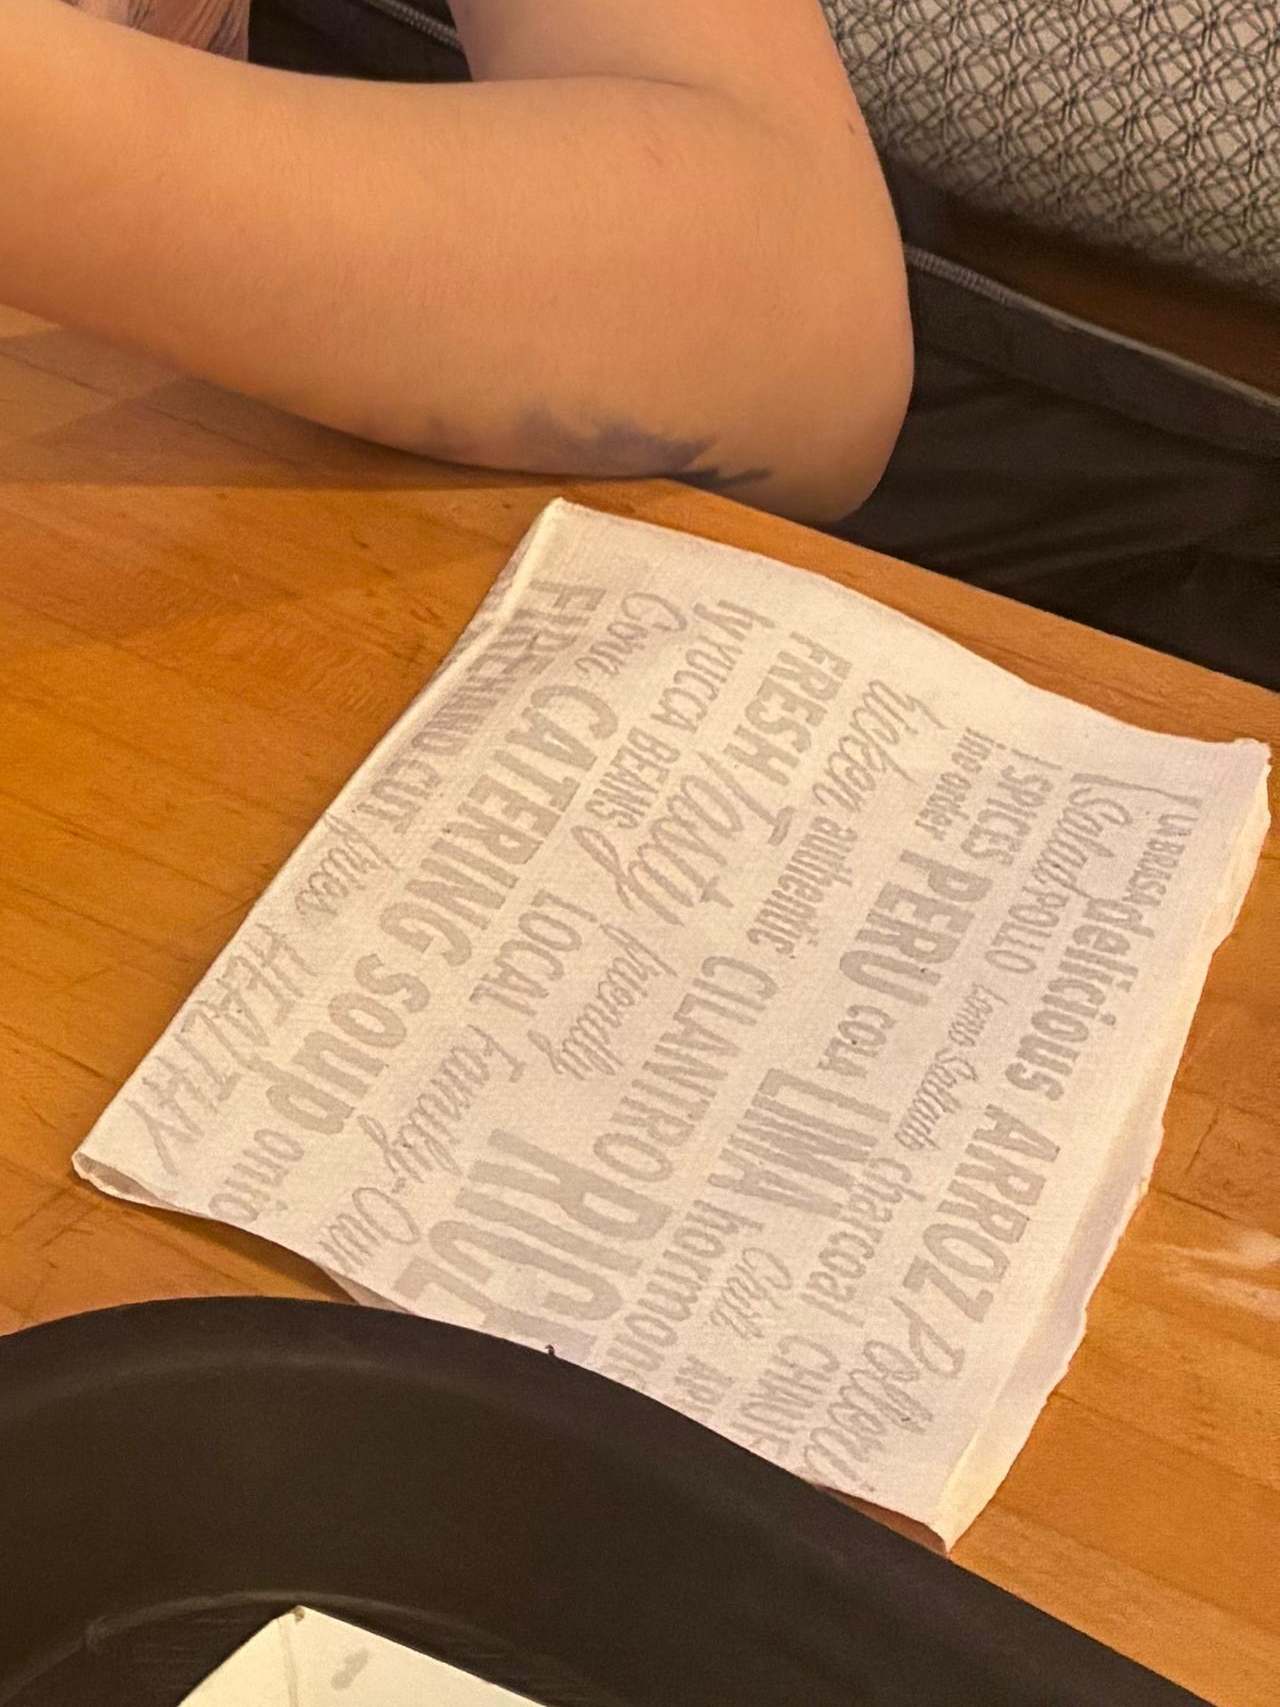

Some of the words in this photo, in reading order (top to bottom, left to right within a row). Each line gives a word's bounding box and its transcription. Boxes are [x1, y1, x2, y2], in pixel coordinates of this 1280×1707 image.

[650, 634, 742, 733] YUCCA
[723, 631, 851, 785] FRESH
[354, 752, 443, 834] CUT
[379, 685, 617, 965] CATERING
[572, 730, 794, 925] Tasty
[585, 727, 680, 829] BEANS
[914, 772, 972, 840] order
[960, 765, 1052, 866] SPICES
[1031, 787, 1131, 903] Salad
[468, 889, 597, 1016] LOCAL
[746, 816, 858, 959] authentic
[839, 849, 991, 1005] PERU
[983, 885, 1068, 974] POLLO
[126, 923, 318, 1176] HEALTHY
[527, 923, 676, 1080] friendly
[593, 956, 776, 1181] CILANTRO
[816, 1004, 896, 1078] COLA
[1005, 893, 1154, 1100] delicious
[707, 1068, 889, 1218] LIMA
[893, 1046, 979, 1151] Saltado
[395, 1131, 668, 1374] RICE
[801, 1154, 925, 1325] charcoal
[902, 1105, 1060, 1321] ARROZ
